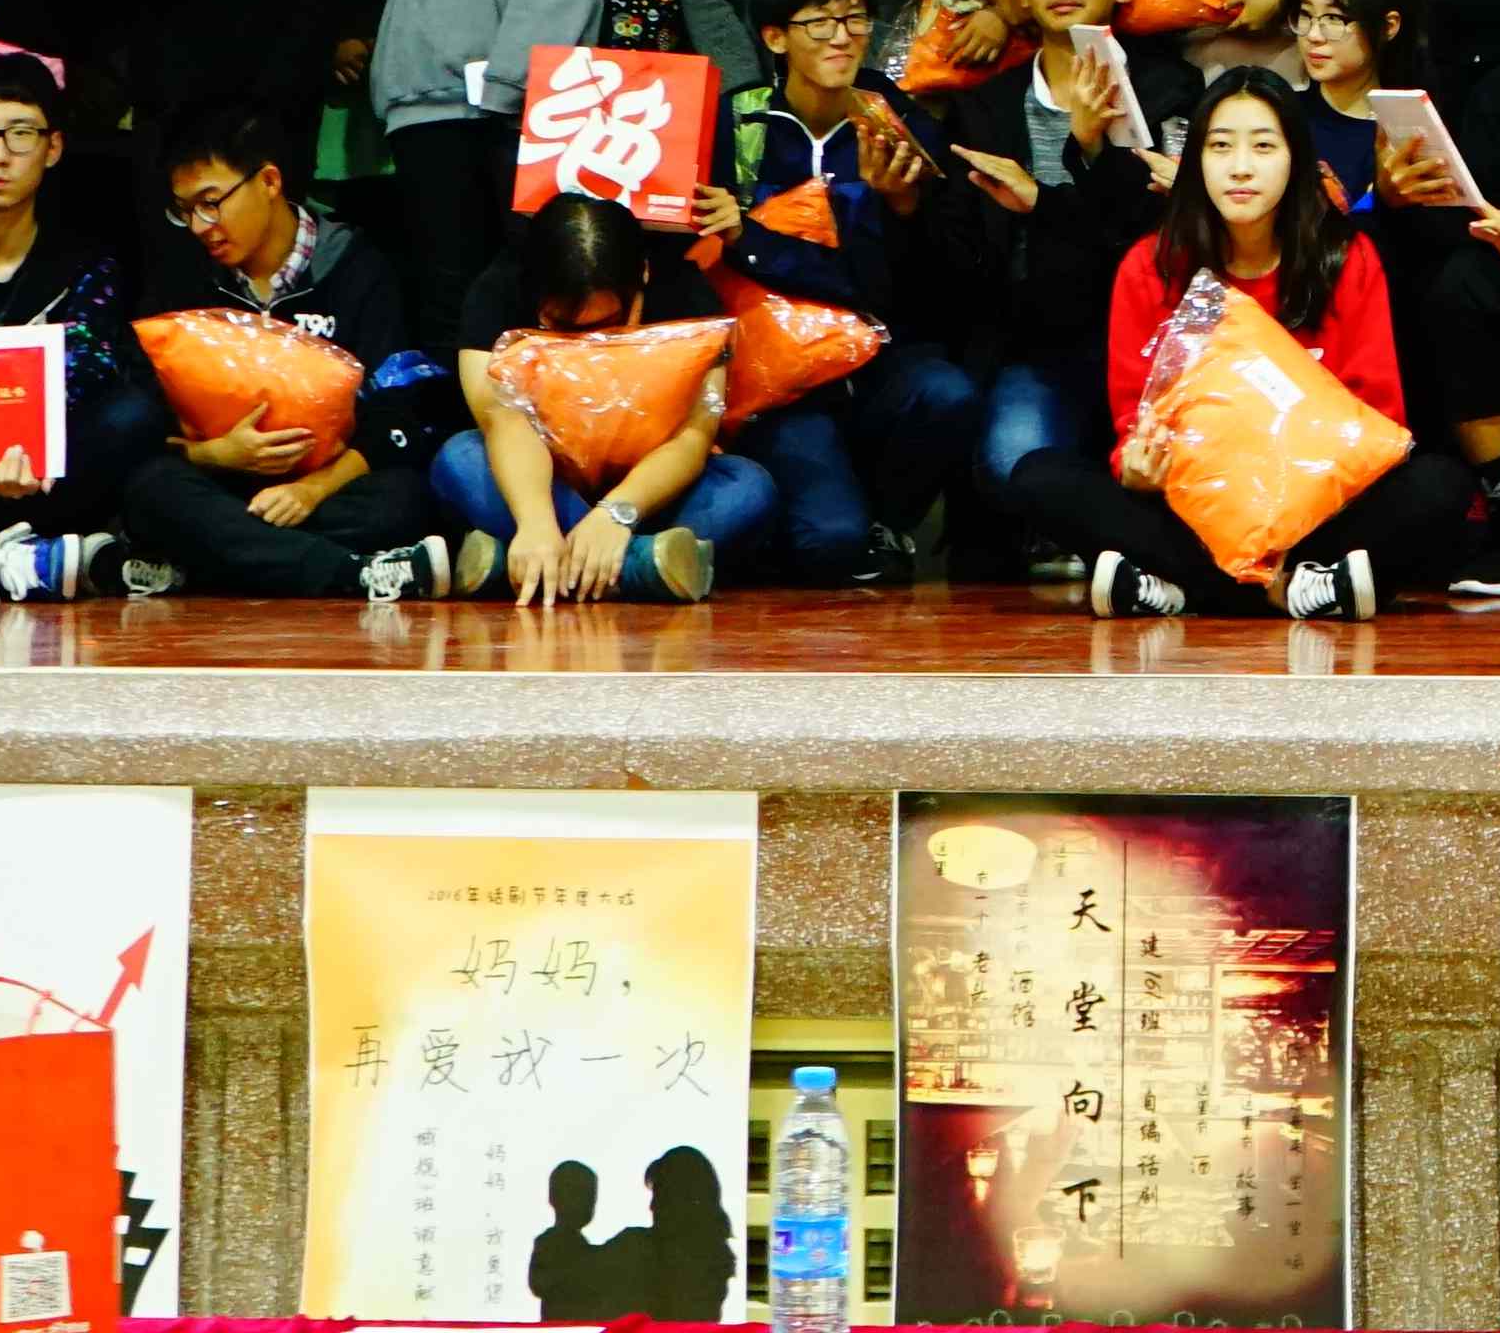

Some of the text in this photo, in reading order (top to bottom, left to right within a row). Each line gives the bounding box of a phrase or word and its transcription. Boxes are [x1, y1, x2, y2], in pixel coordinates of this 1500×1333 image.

[343, 1024, 710, 1097] 再爱我一次
[1061, 889, 1112, 1223] 天堂向下
[1137, 1088, 1163, 1207] 自编话剧
